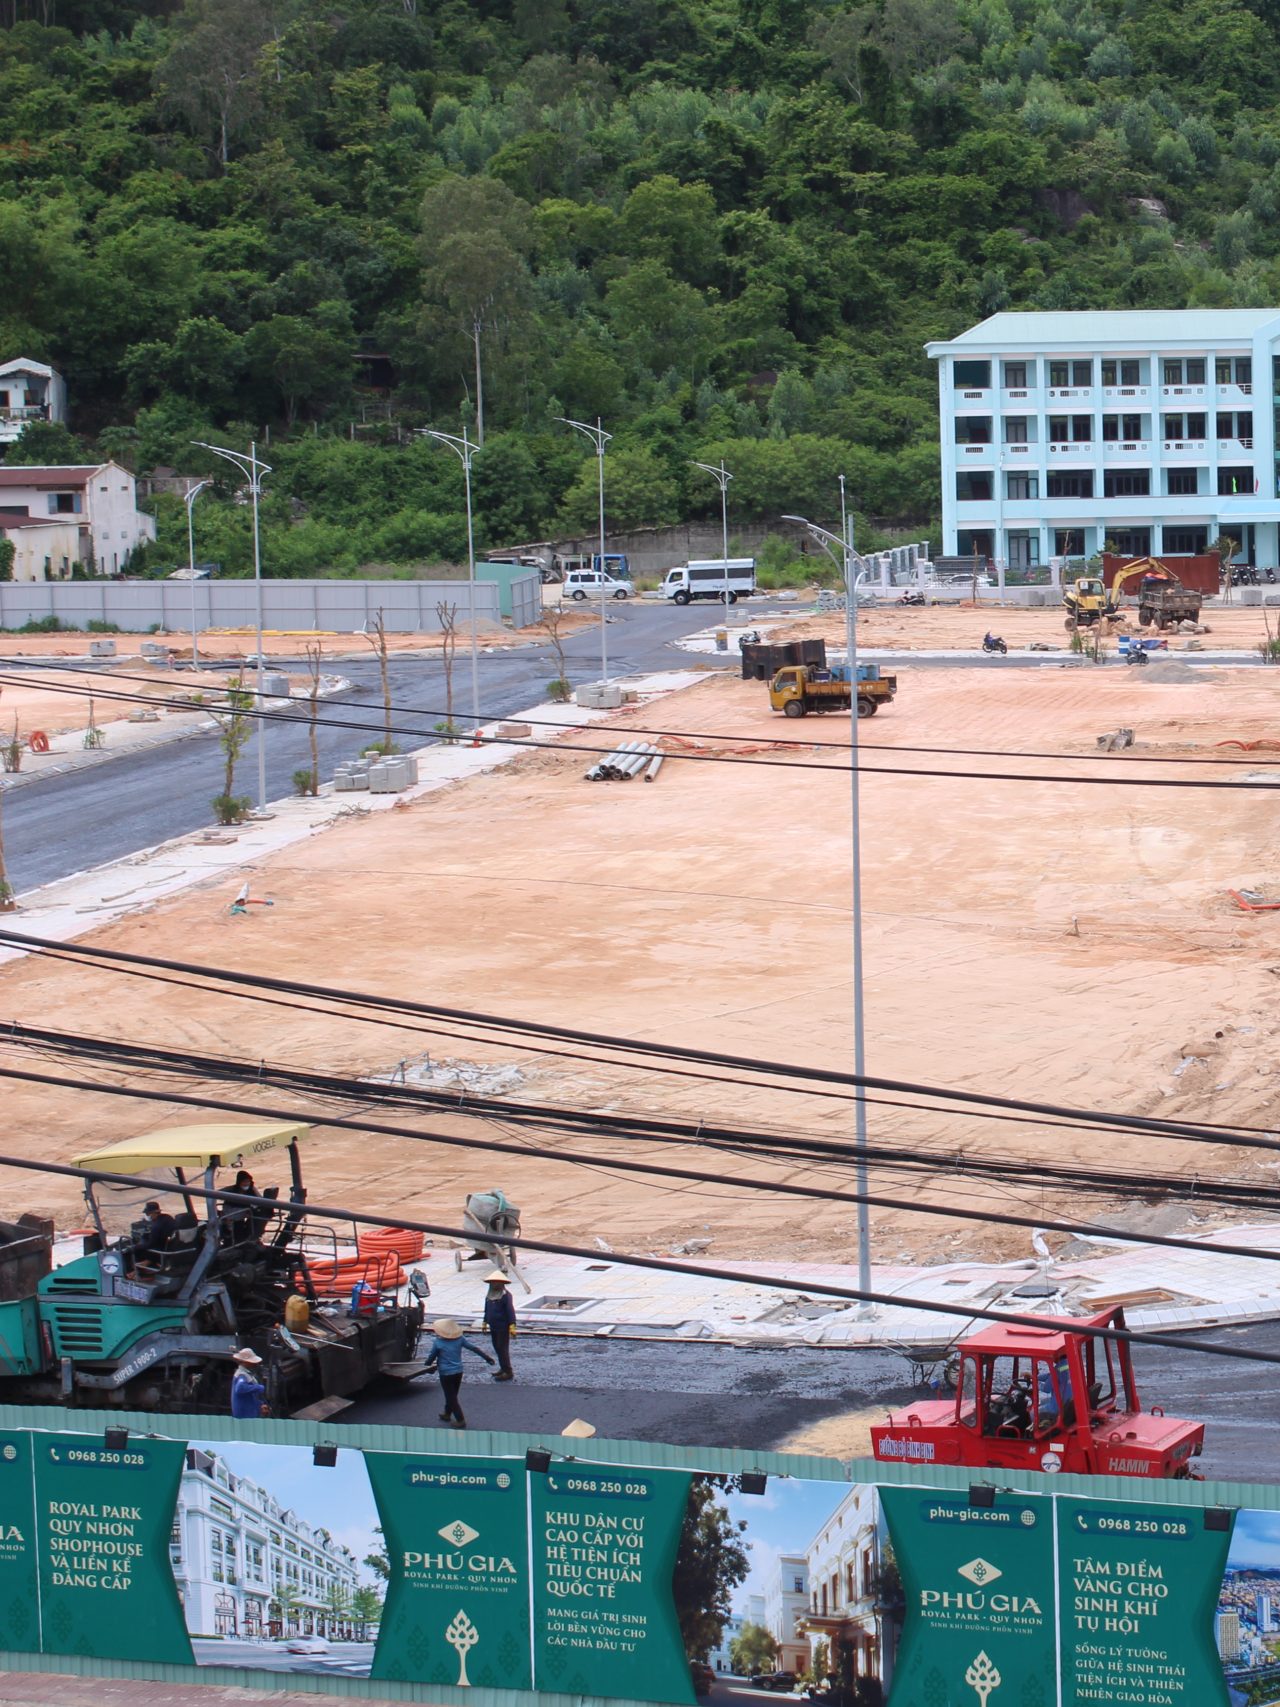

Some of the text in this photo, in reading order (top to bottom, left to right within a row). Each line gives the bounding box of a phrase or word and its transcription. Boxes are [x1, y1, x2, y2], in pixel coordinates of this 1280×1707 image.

[114, 1348, 158, 1384] SUPER 1900-2
[68, 1450, 144, 1464] 0968 250 028
[1108, 1458, 1150, 1474] HAMM
[412, 1471, 486, 1484] phu-gia.com
[568, 1480, 647, 1495] 0968 250 028
[49, 1501, 142, 1520] ROYAL PARK
[930, 1506, 1010, 1521] phu-gia.com
[49, 1518, 134, 1536] QUY NHƠN
[546, 1511, 644, 1531] KHU DÂN CƯ
[1098, 1518, 1186, 1534] 0968 250 028
[50, 1538, 144, 1556] SHOPHOUSE
[546, 1528, 644, 1548] CAO CẤP VỚI
[50, 1552, 70, 1569] VÀ
[403, 1551, 518, 1574] PHÚ GIA
[546, 1544, 640, 1566] HỆ TIỆN ÍCH
[546, 1562, 642, 1583] TIÊU CHUẨN
[1073, 1556, 1164, 1578] TÂM ĐIỂM
[100, 1573, 132, 1590] CẤP
[404, 1571, 432, 1579] ROYAL
[468, 1575, 486, 1584] QUY
[1074, 1574, 1168, 1598] VÀNG CHO
[546, 1578, 616, 1598] QUỐC TẾ
[920, 1590, 1042, 1614] PHÚ GIA
[1074, 1596, 1158, 1616] SINH KHÍ
[548, 1608, 647, 1624] MANG GIÁ TRỊ SINH
[921, 1610, 952, 1618] ROYAL
[955, 1612, 980, 1620] PARK
[989, 1614, 1010, 1624] QUY
[1074, 1614, 1140, 1636] TỤ HỘI
[568, 1621, 588, 1633] BỀN
[623, 1628, 646, 1638] CHO
[547, 1634, 636, 1652] CÁC NHÀ ĐẦU TƯ
[1076, 1642, 1168, 1660] SỐNG LÝ TƯỞNG
[1076, 1658, 1186, 1676] GIỮA HỆ SINH THÁI
[1076, 1672, 1184, 1690] TIỆN ÍCH VÀ THIÊN
[1076, 1688, 1172, 1704] NHIÊN GIAO HÒA
